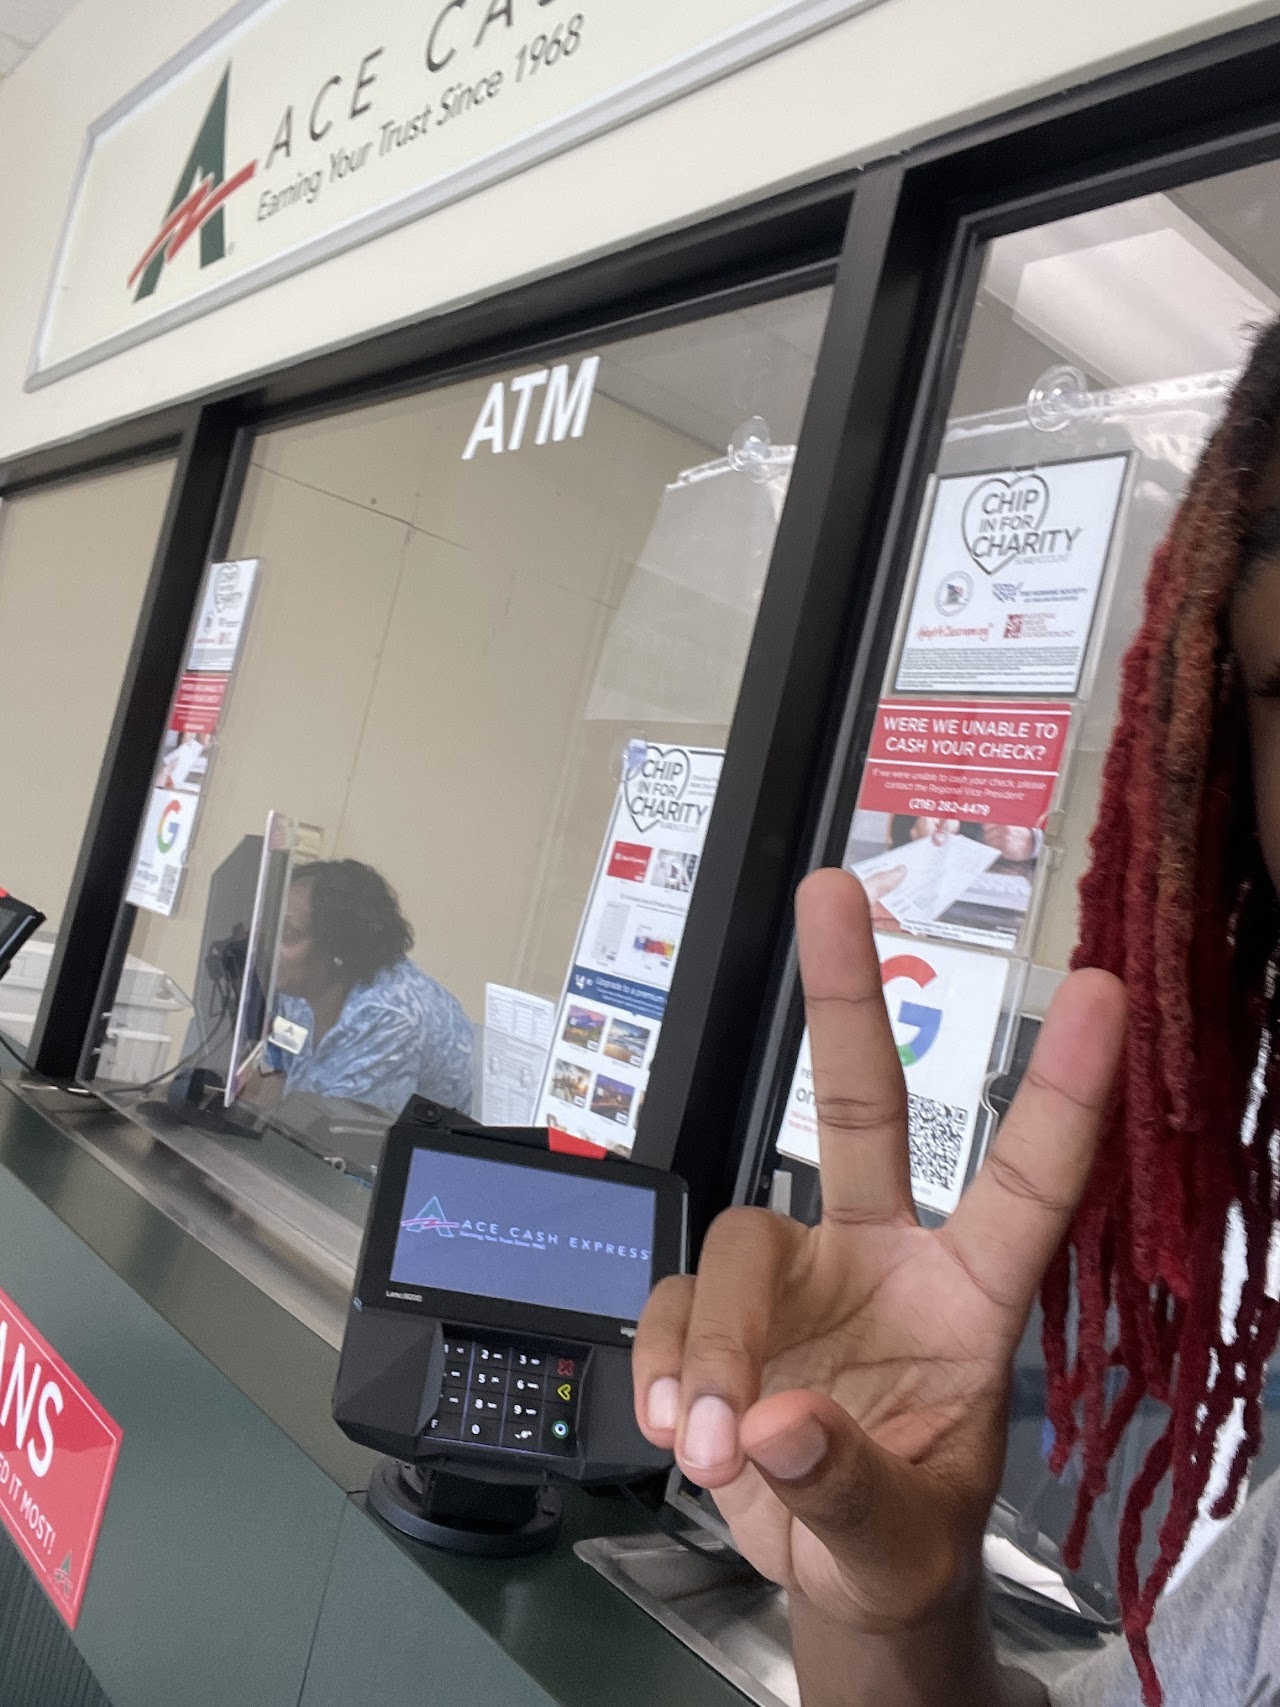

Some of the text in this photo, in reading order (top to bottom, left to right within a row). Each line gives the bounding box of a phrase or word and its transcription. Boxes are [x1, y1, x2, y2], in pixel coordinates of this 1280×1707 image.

[265, 0, 557, 170] ACE CA
[257, 13, 584, 221] Earning Your Trust Since 1968
[461, 355, 600, 460] ATM
[983, 489, 1038, 515] CHIP
[979, 515, 1034, 533] IN FOR
[973, 528, 1082, 557] CHARITY
[883, 716, 1059, 739] WERE WE UNABLE TO
[885, 736, 1046, 761] CASH YOUR CHECK?
[641, 759, 683, 781] CHIP
[638, 779, 651, 793] IN
[652, 782, 677, 797] FOR
[630, 795, 708, 825] CHARITY
[461, 1219, 499, 1235] ACE
[509, 1226, 558, 1245] CASH
[569, 1236, 650, 1261] EXPRESS
[517, 1379, 524, 1390] 6
[0, 1320, 64, 1478] NS
[513, 1404, 522, 1415] 9
[8, 1473, 22, 1501] IT
[20, 1490, 56, 1555] MOST!
